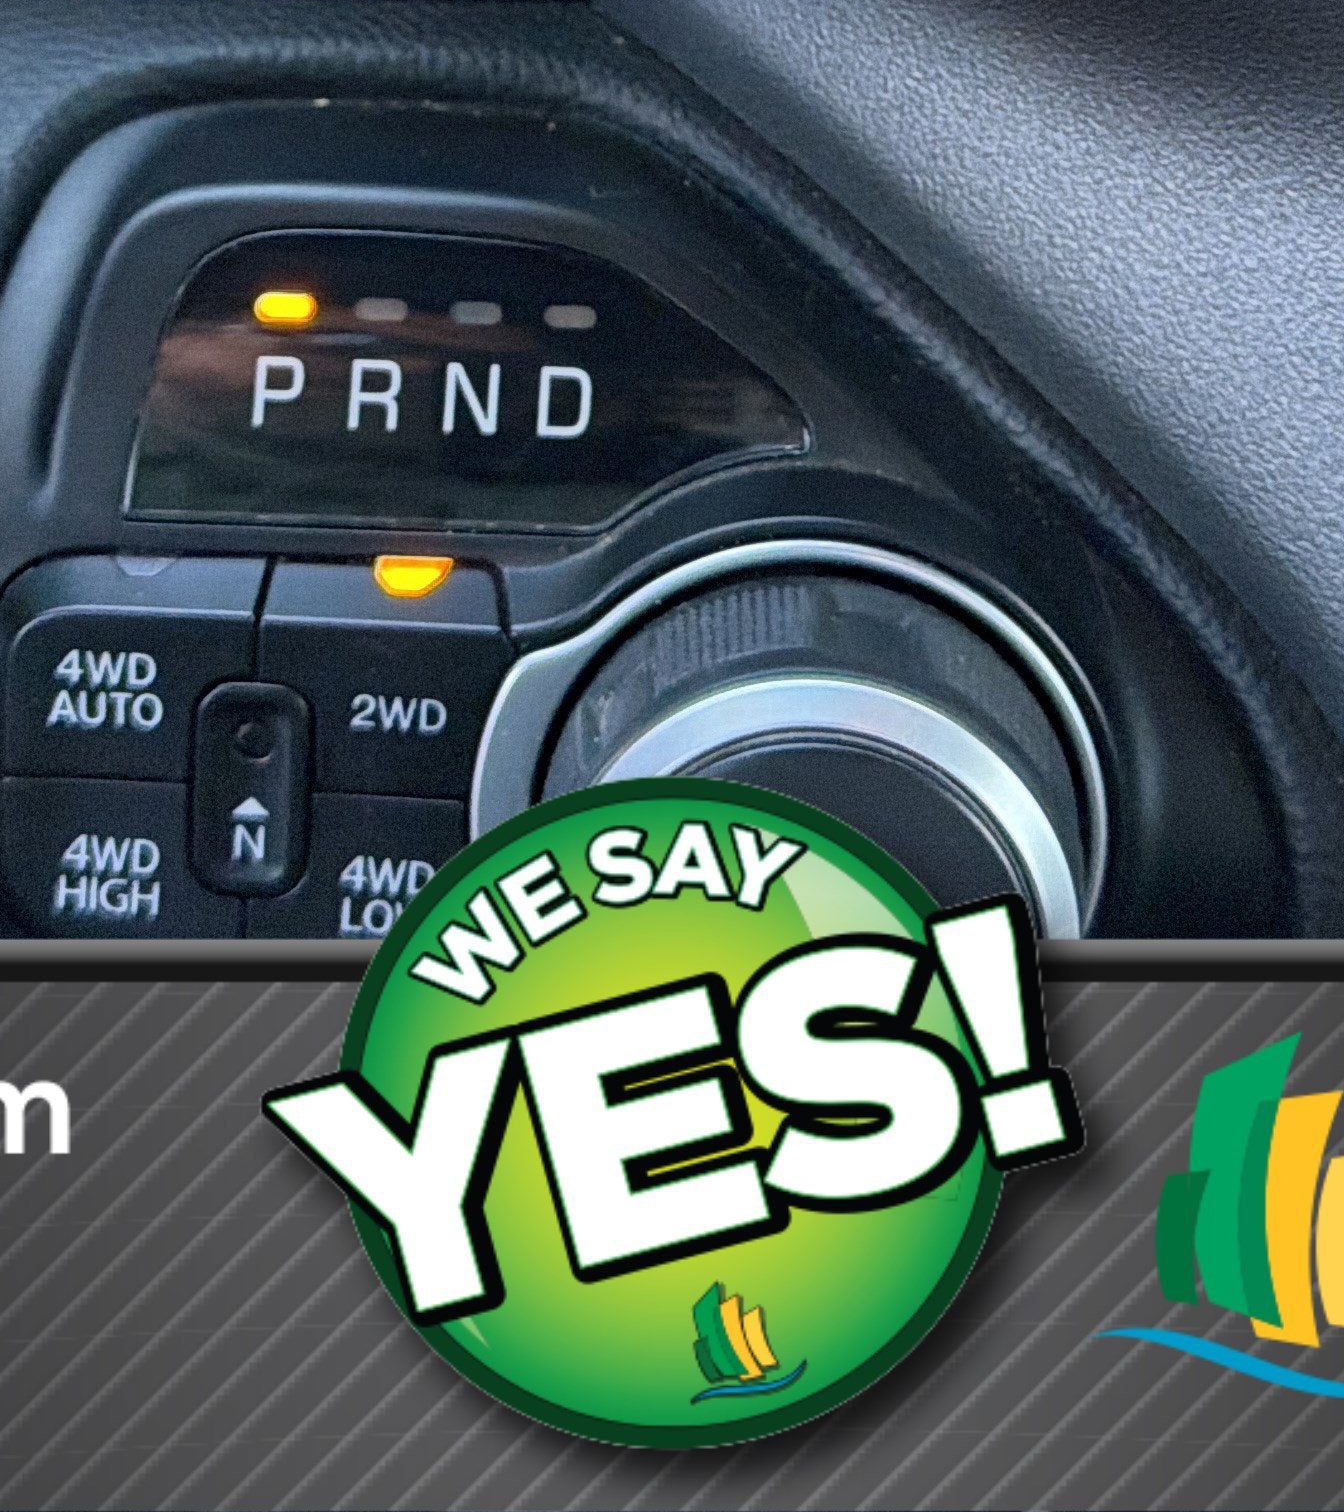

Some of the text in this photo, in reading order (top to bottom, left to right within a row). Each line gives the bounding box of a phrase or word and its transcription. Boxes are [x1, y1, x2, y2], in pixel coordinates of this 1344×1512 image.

[56, 649, 157, 688] 4WD
[46, 691, 164, 730] AUTO
[349, 693, 447, 735] 2WD
[62, 834, 160, 877] 4WD
[231, 824, 266, 862] N
[338, 854, 435, 896] 4WD
[54, 878, 160, 918] HIGH
[339, 896, 404, 937] LO
